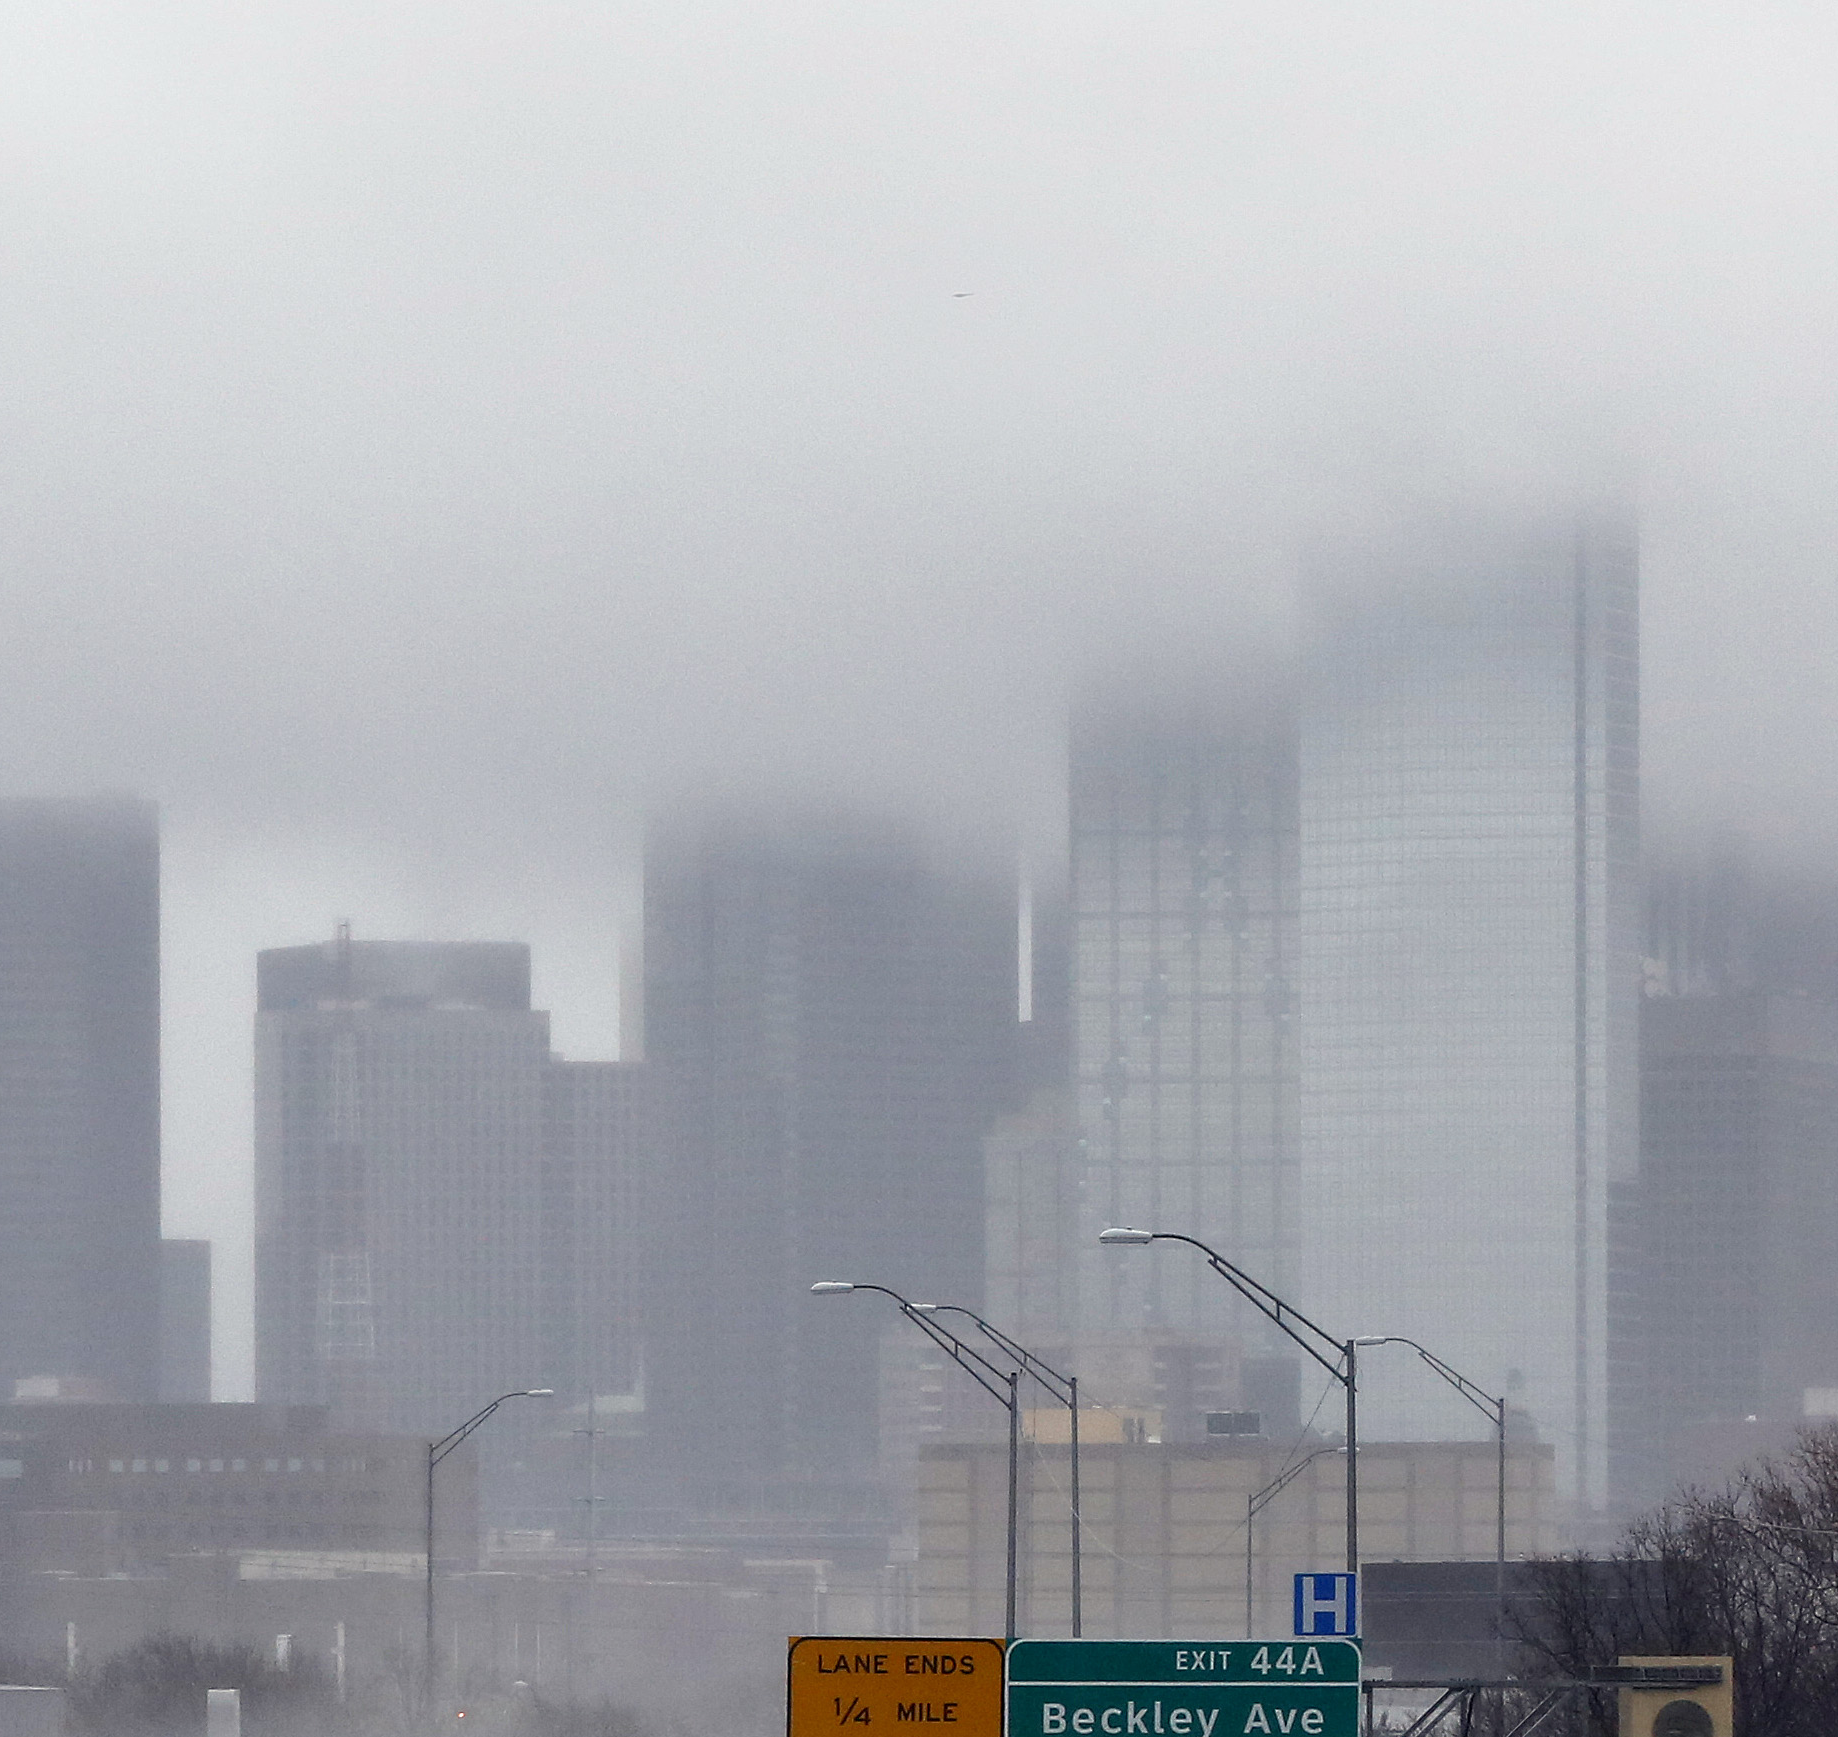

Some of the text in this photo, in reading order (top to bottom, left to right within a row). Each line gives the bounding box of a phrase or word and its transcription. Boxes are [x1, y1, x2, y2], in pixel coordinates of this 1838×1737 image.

[1302, 1576, 1347, 1633] H
[818, 1655, 974, 1674] LANE ENDS
[1176, 1647, 1324, 1675] EXIT 44A
[897, 1703, 958, 1722] MILE
[1244, 1703, 1324, 1734] Ave
